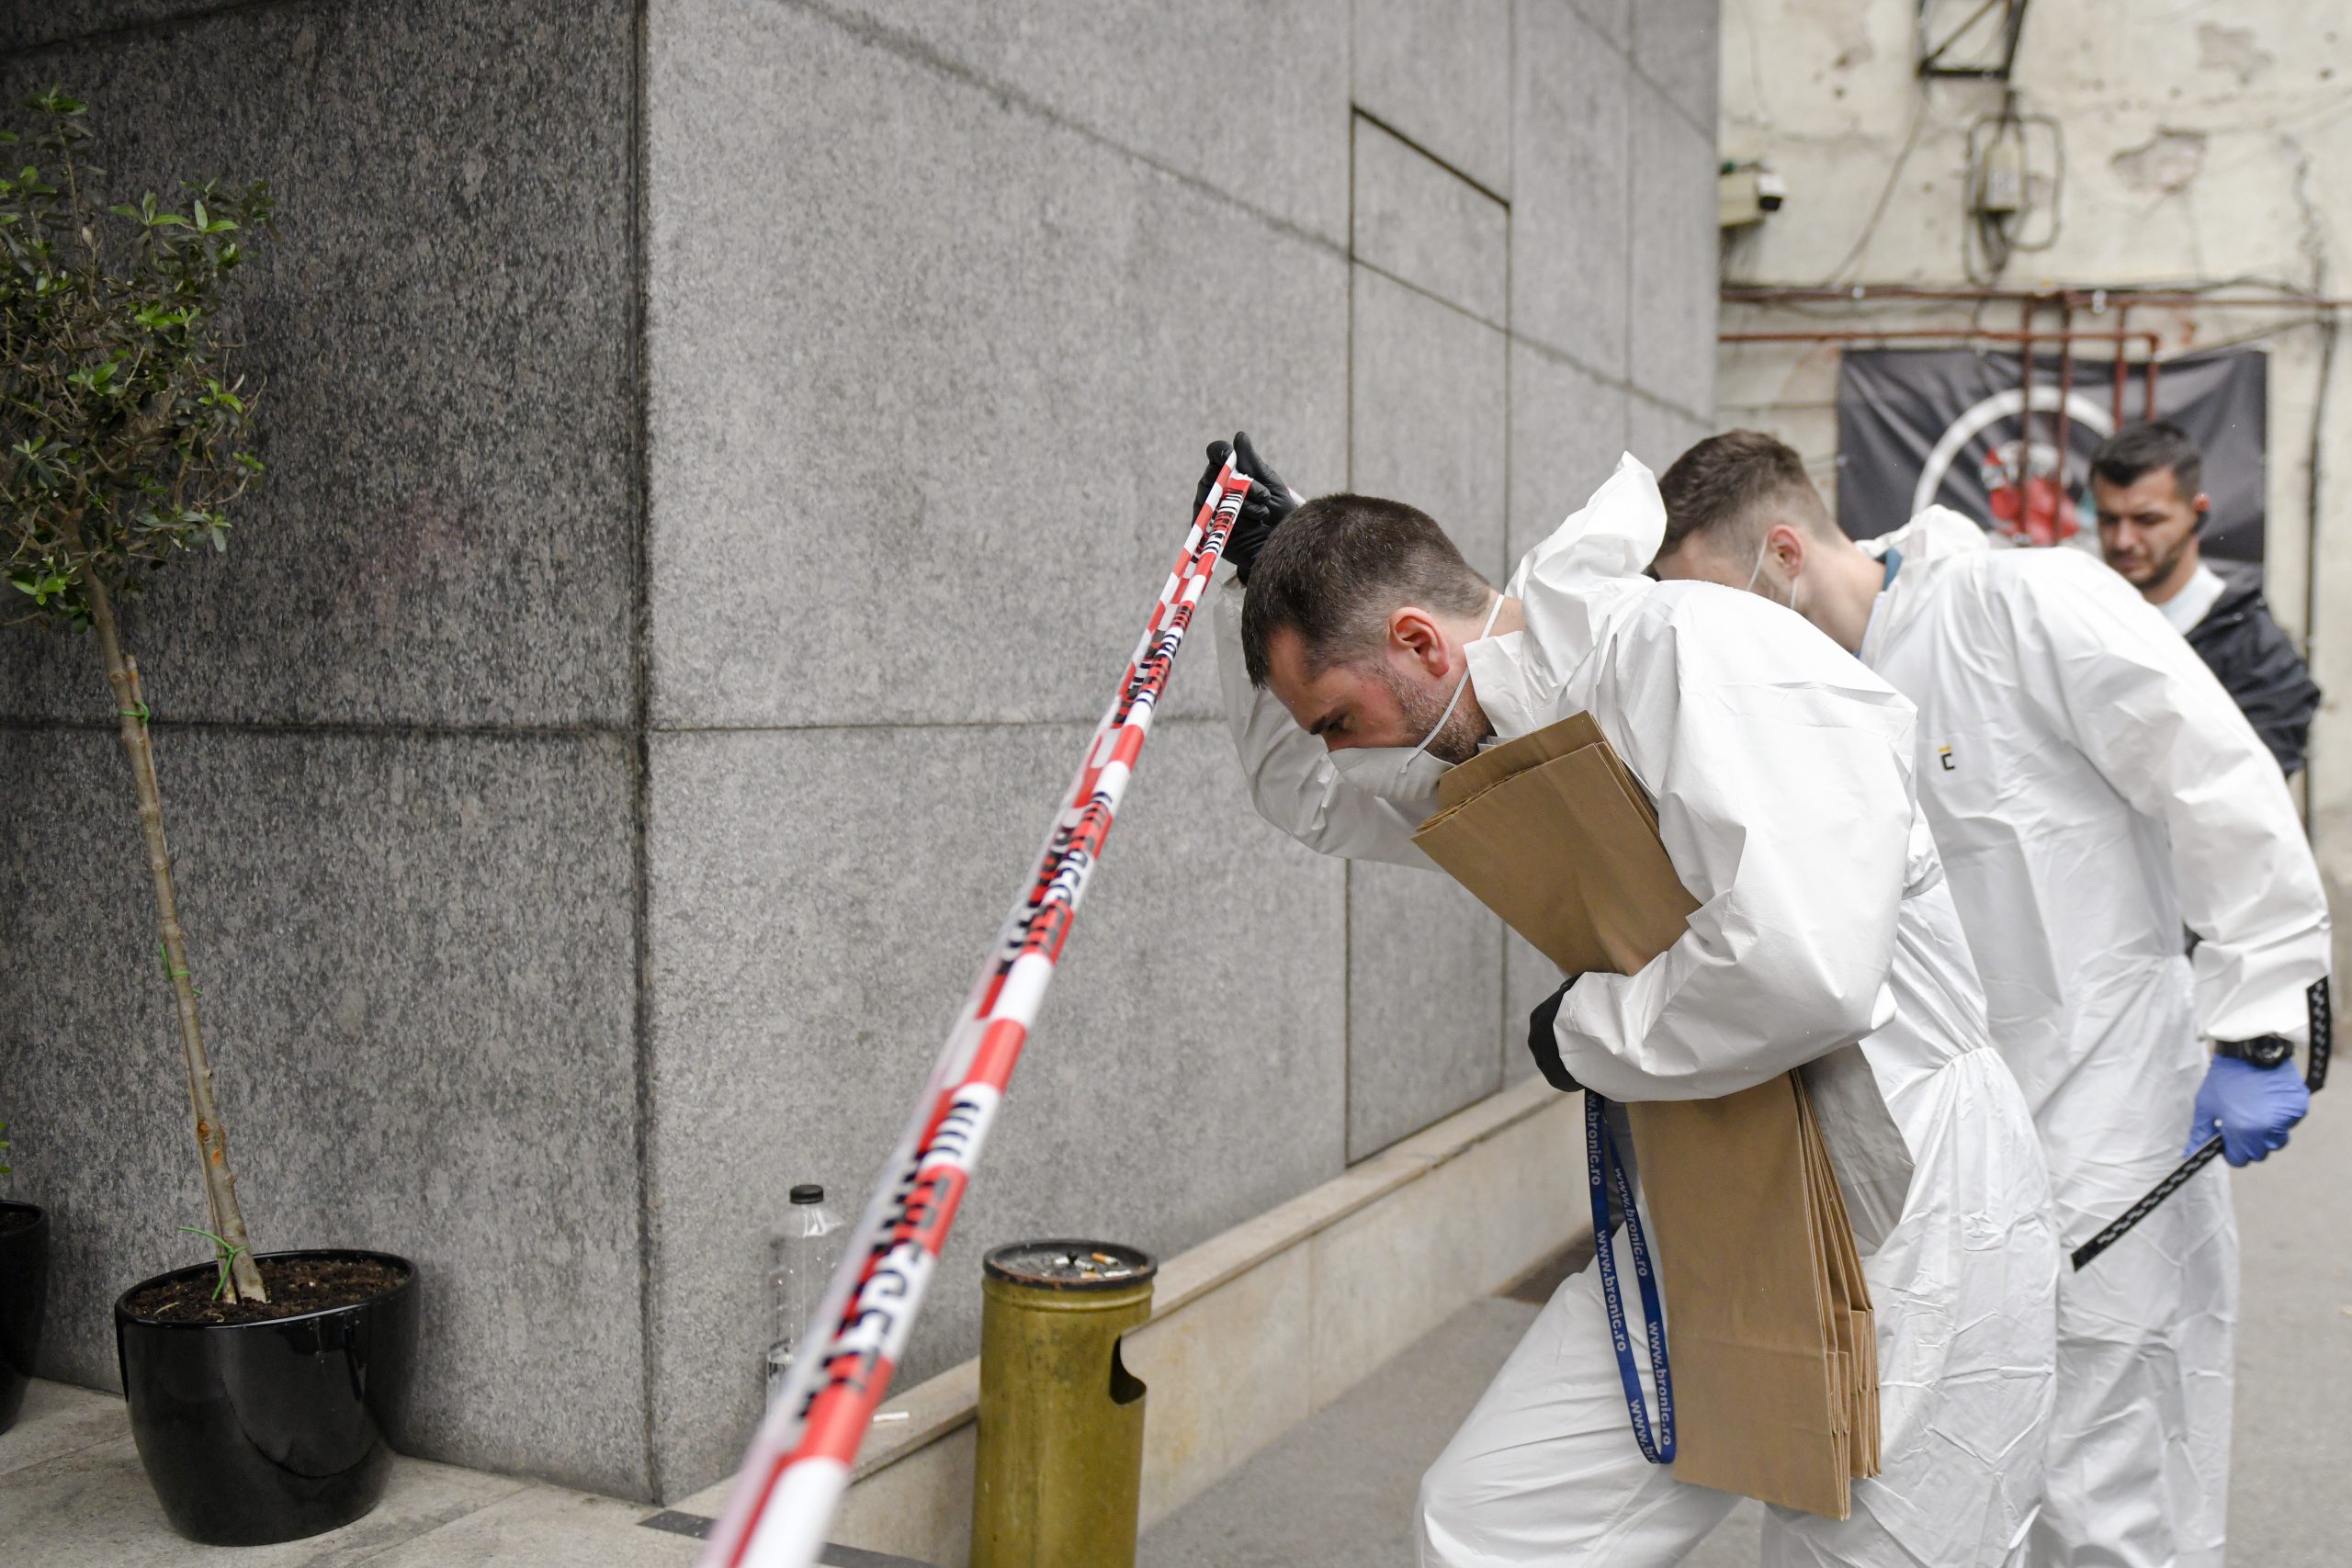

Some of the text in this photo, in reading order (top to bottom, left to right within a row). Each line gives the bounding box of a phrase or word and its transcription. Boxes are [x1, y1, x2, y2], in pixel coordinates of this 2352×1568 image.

[1614, 1168, 1648, 1277] www.bronic.ro
[1597, 1230, 1626, 1352] www.bronic.ro
[1647, 1321, 1670, 1446] www.bronic.ro
